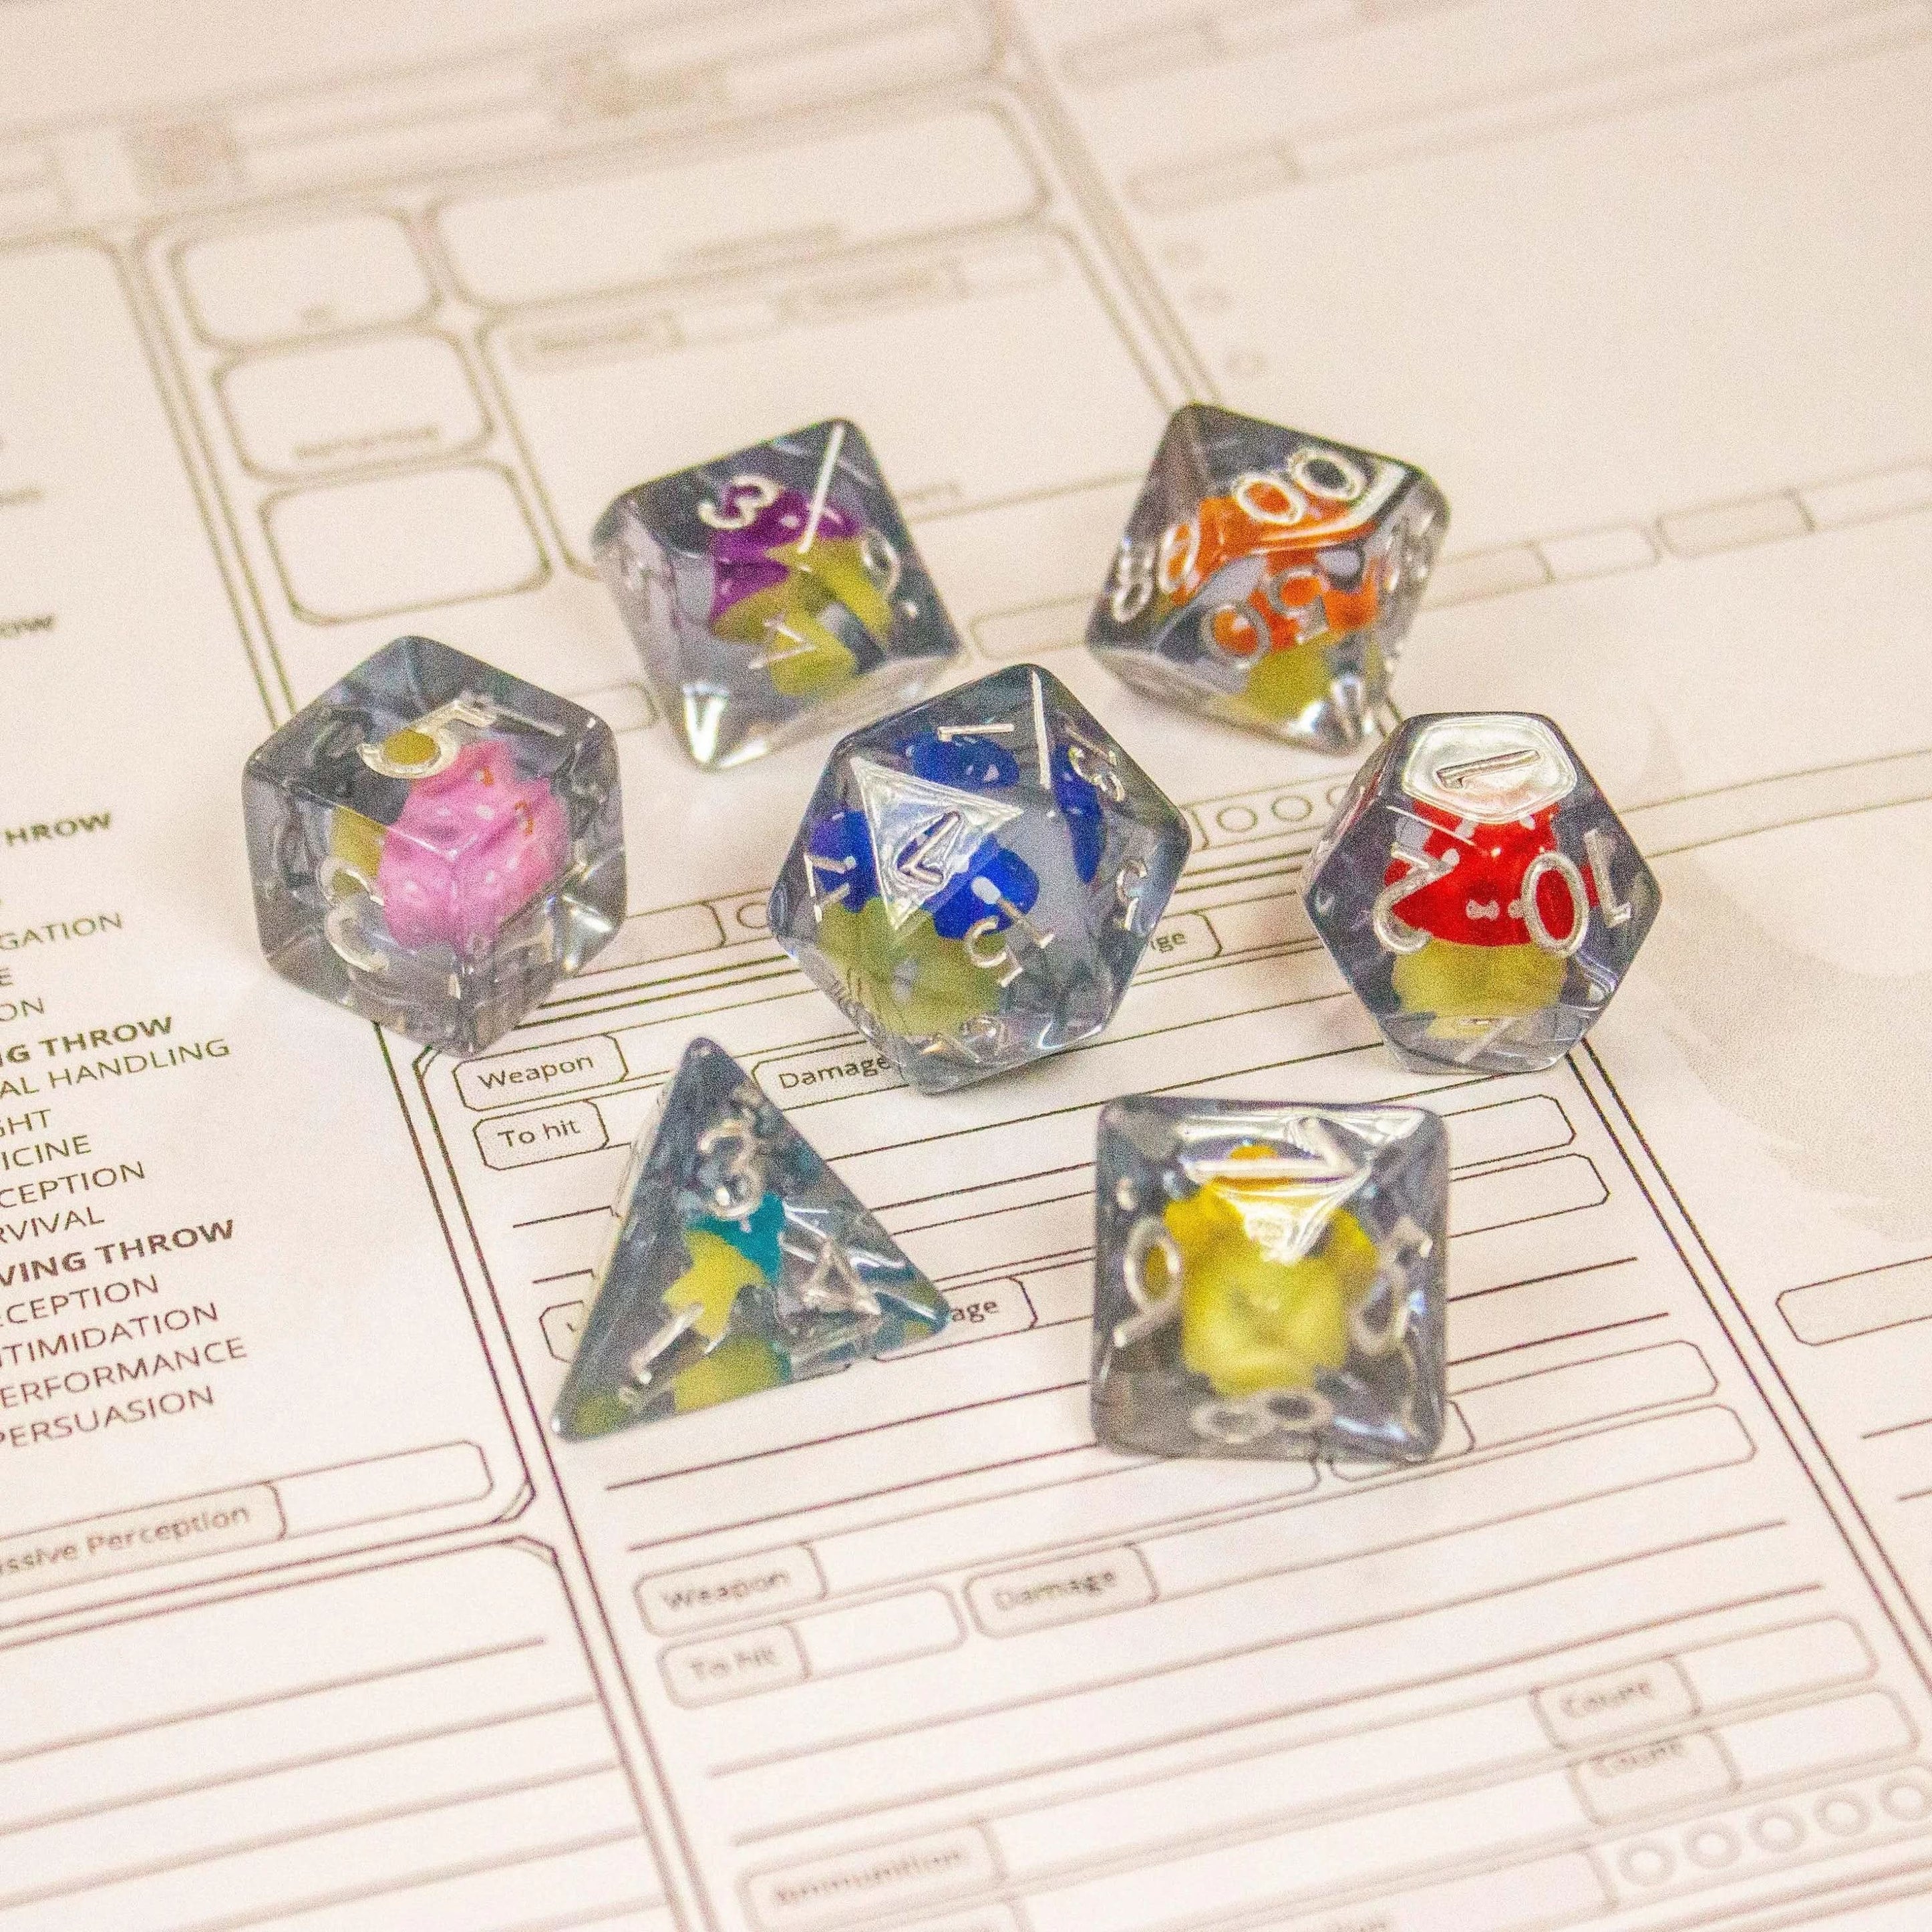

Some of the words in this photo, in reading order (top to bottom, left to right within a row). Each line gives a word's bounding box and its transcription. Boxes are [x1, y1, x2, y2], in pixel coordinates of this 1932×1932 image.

[695, 472, 785, 530] 3
[3, 809, 112, 848] HROW
[0, 1043, 32, 1068] G
[37, 1015, 172, 1056] THROW
[47, 1037, 231, 1090] HANDLING
[477, 1054, 595, 1090] Weapon
[777, 1056, 892, 1089] Damage
[497, 1129, 536, 1148] To
[542, 1119, 581, 1140] hit
[0, 1161, 146, 1208] CEPTION
[94, 1219, 234, 1265] THROW
[0, 1273, 160, 1327] CEPTION
[0, 1301, 219, 1370] TIMIDATION
[0, 1336, 249, 1409] ERFORMANCE
[0, 1544, 78, 1575] ssive
[87, 1506, 251, 1557] Perception
[660, 1569, 792, 1611] Weapon
[992, 1569, 1118, 1612] Damage
